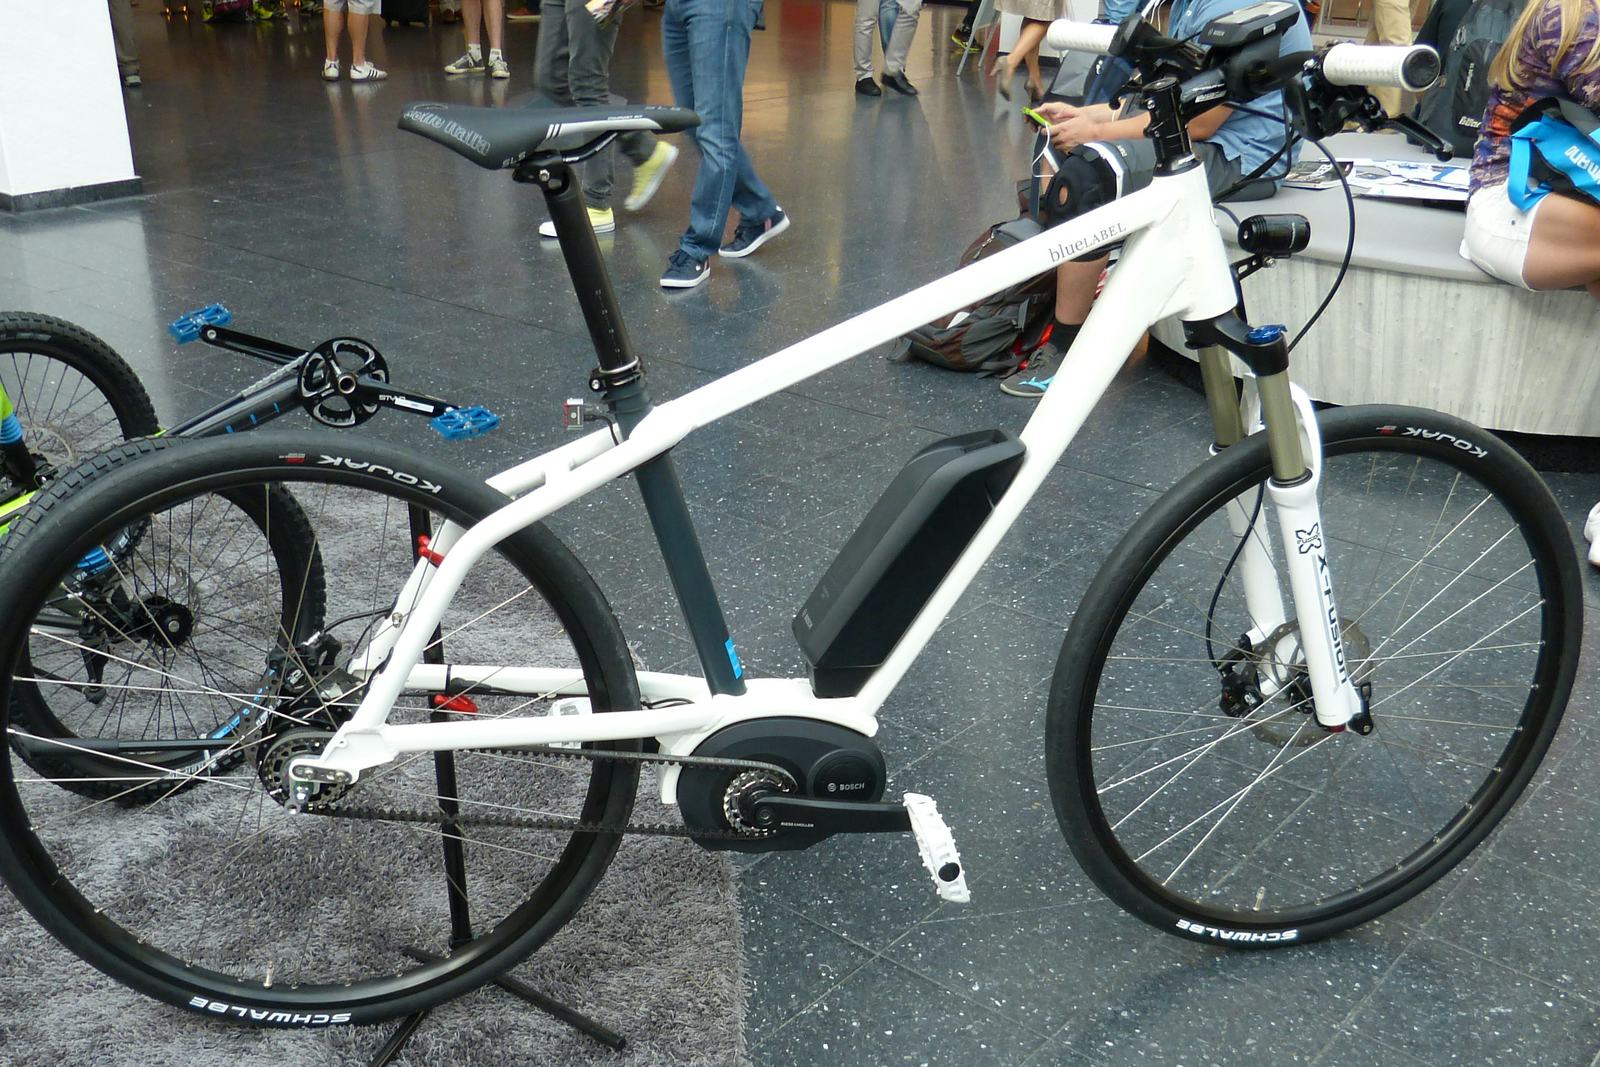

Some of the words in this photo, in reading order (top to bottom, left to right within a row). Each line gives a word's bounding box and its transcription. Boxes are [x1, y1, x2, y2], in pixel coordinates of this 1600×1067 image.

[1402, 426, 1488, 459] KOJAK
[316, 454, 443, 495] KOJAK
[839, 782, 865, 792] BOSCH
[1175, 918, 1298, 942] SCHWALBE
[188, 995, 352, 1024] SCHWALBE
